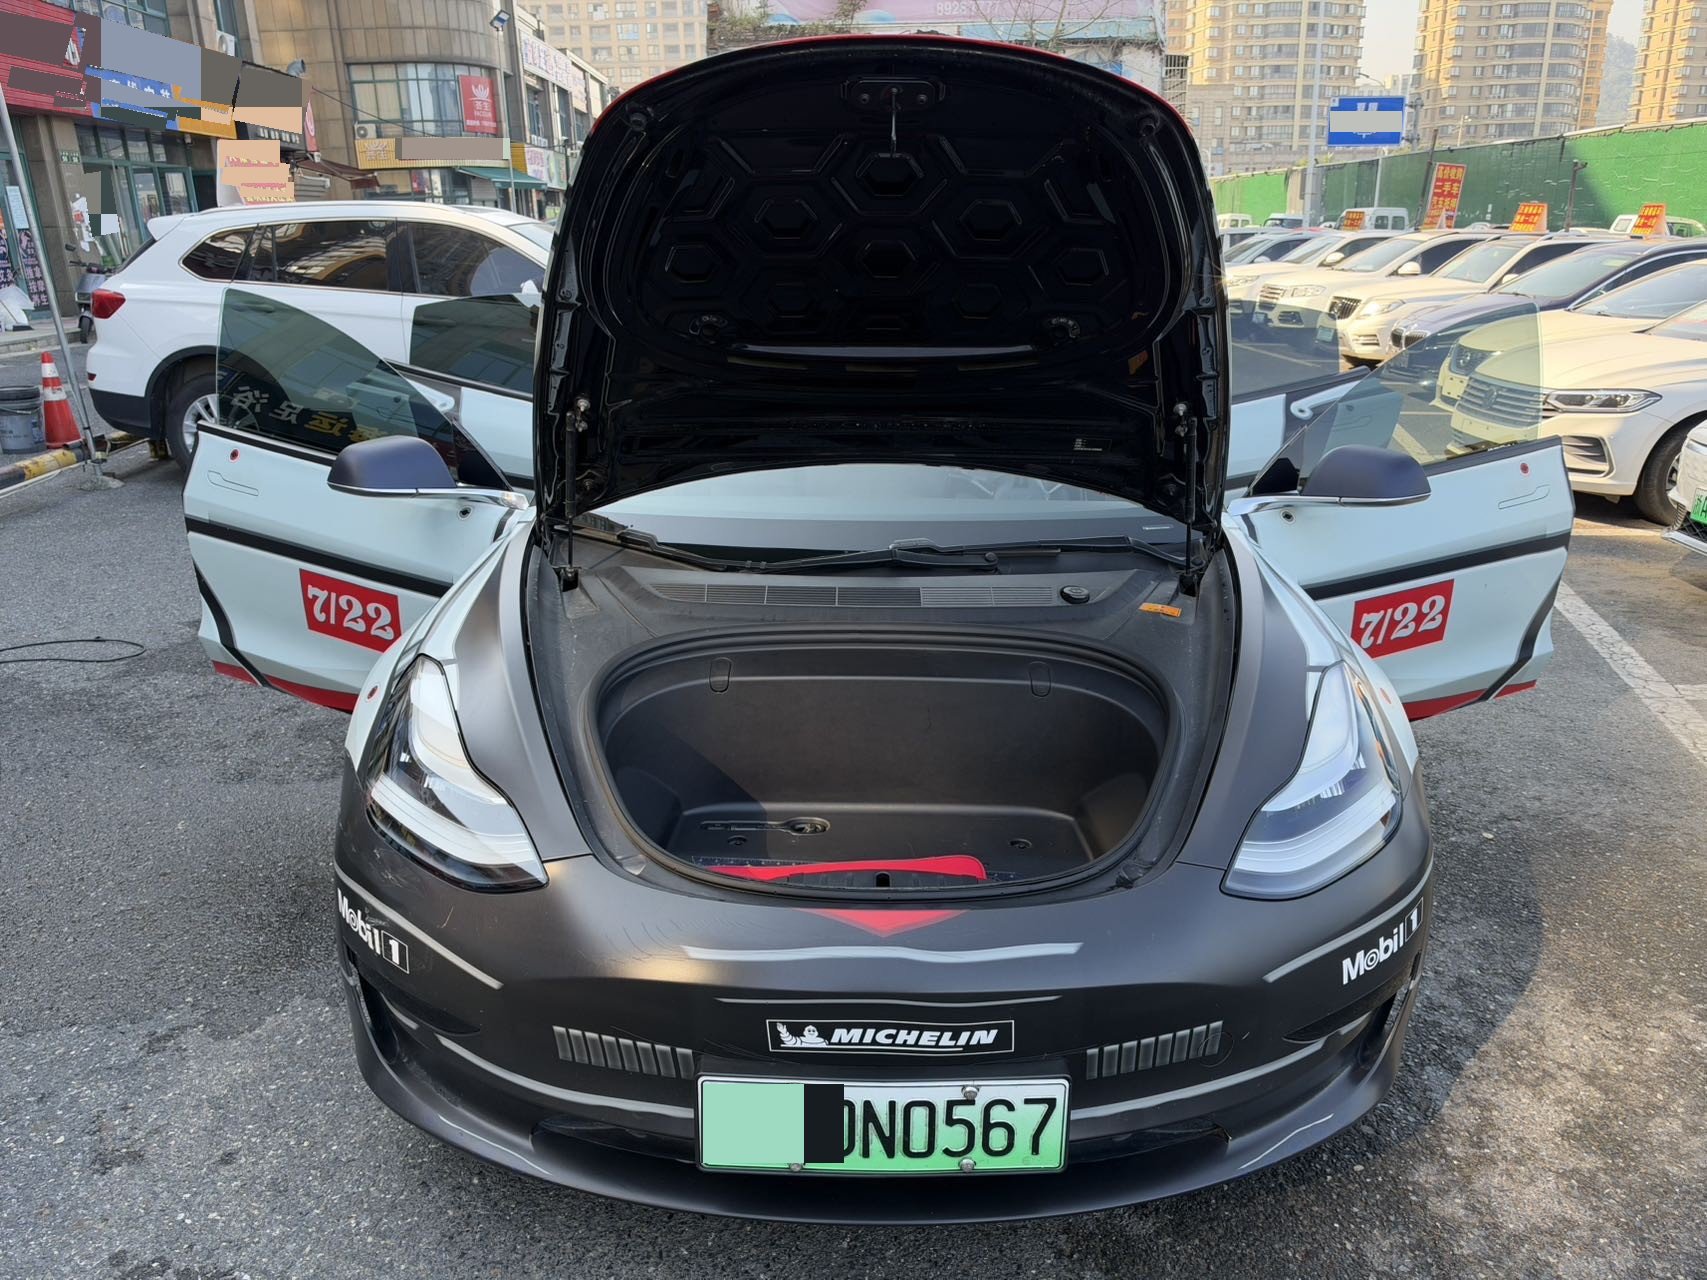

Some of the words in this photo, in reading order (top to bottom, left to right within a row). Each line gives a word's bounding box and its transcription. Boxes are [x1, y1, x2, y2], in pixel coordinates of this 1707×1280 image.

[1434, 182, 1460, 195] 二手车
[1359, 594, 1446, 649] 7/22
[337, 887, 381, 956] Mobil
[388, 939, 400, 965] 1
[1342, 922, 1404, 985] Mobil
[1410, 907, 1418, 932] 1
[830, 1028, 999, 1047] MICHELIN
